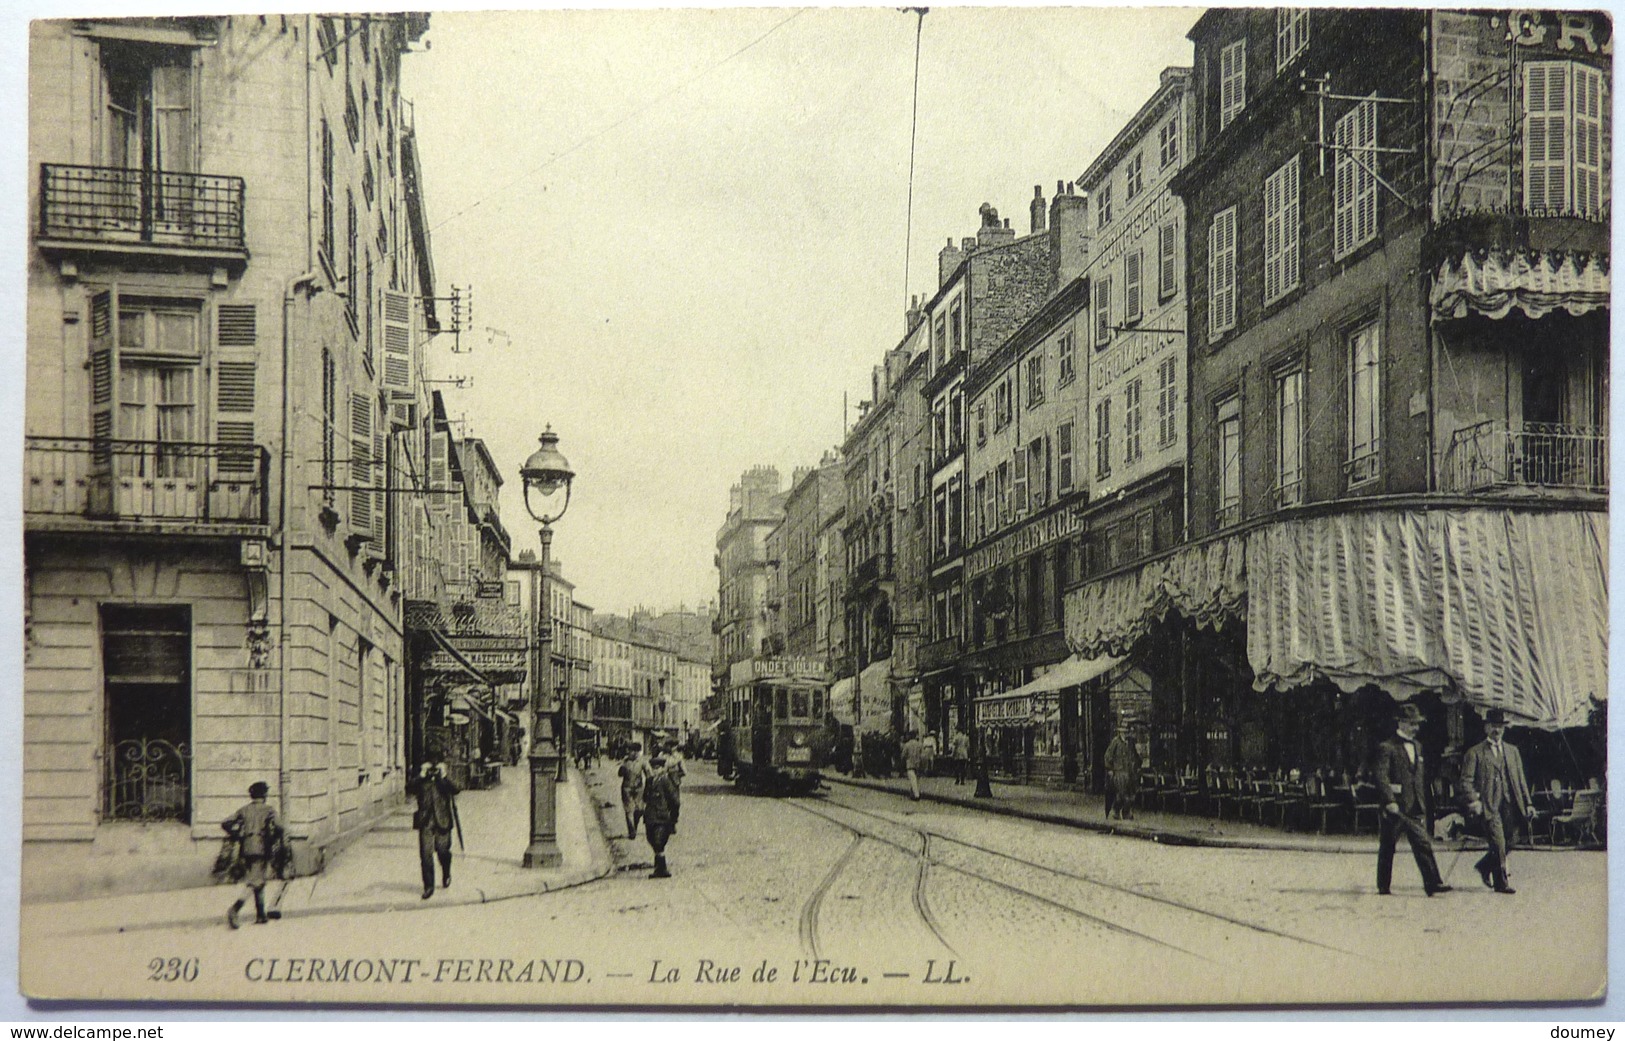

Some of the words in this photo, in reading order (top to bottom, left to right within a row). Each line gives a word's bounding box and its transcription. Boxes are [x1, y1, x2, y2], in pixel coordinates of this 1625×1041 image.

[1100, 190, 1172, 270] CONFISERIE
[968, 540, 1004, 579] GRANDE
[1009, 507, 1080, 559] PHARMACIE
[754, 660, 787, 673] ONDET
